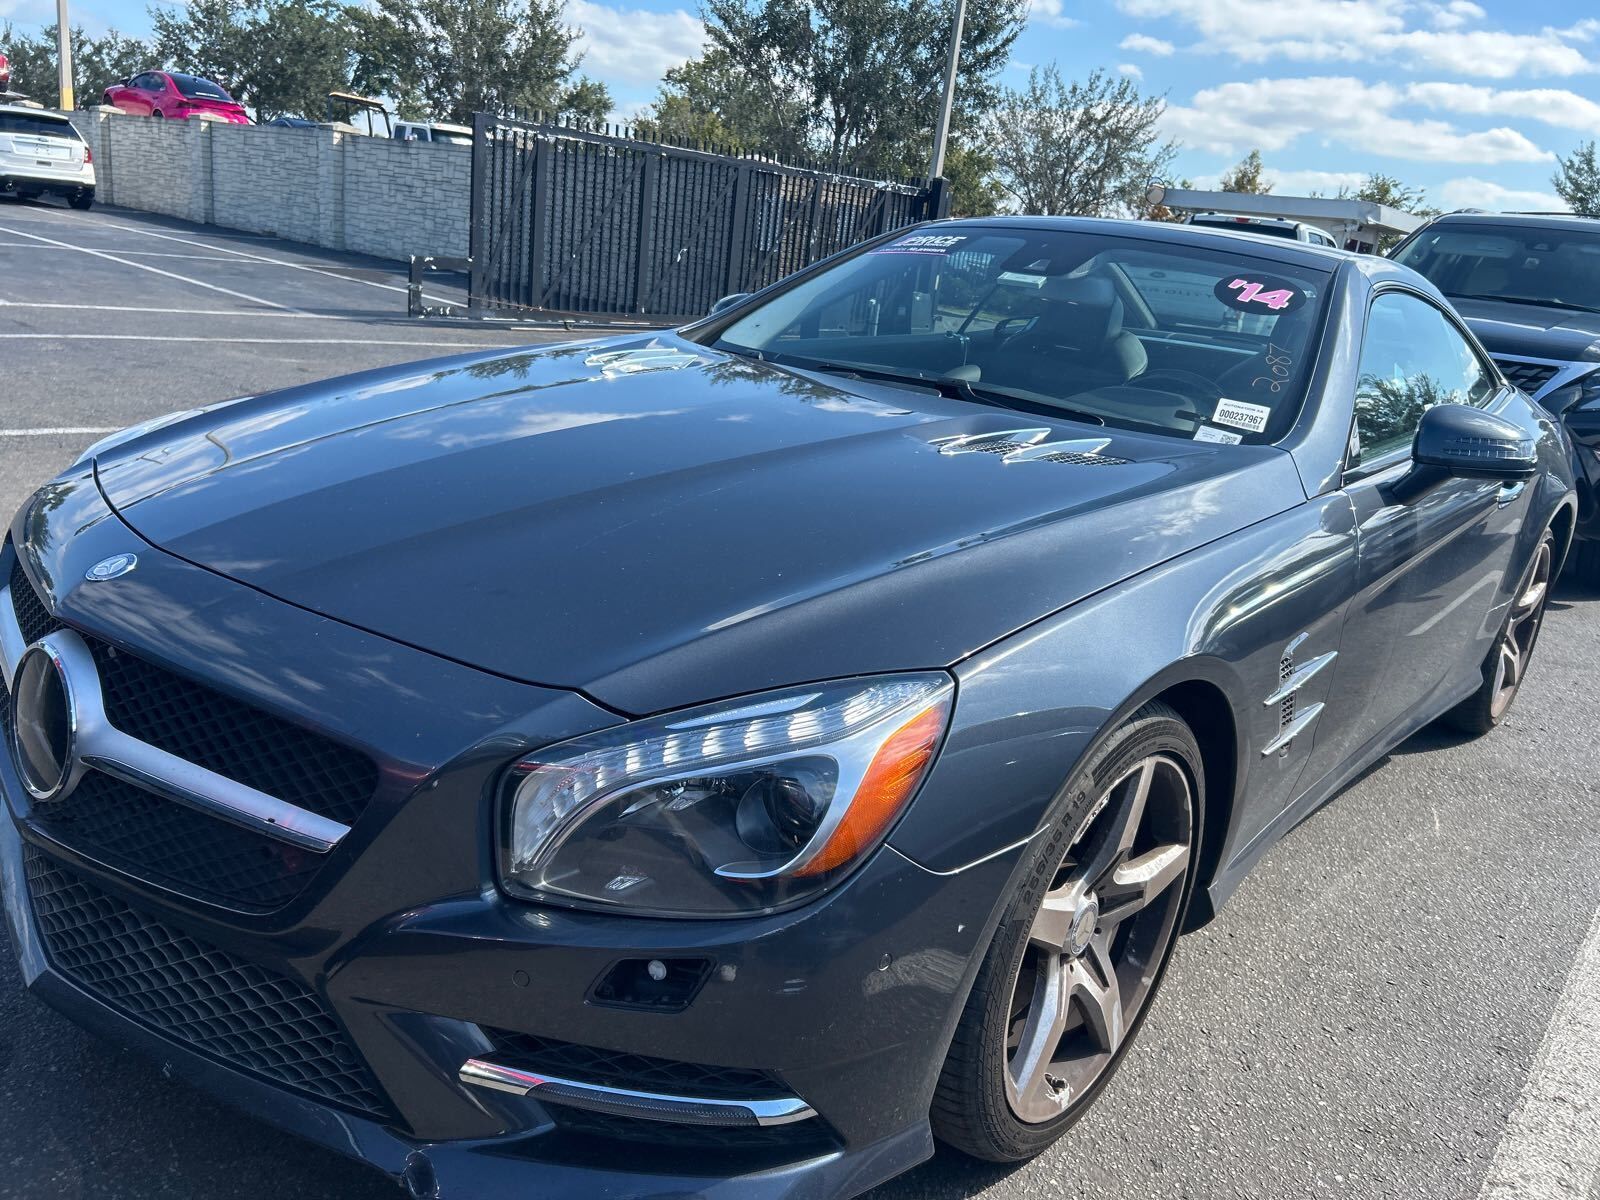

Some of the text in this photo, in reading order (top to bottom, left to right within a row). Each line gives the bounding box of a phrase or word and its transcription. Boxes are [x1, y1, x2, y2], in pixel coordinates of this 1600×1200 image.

[1252, 342, 1292, 392] 2087
[1219, 409, 1264, 425] 000237967
[1024, 830, 1063, 905] 255/35
[1063, 812, 1073, 828] R
[1072, 791, 1086, 810] 19
